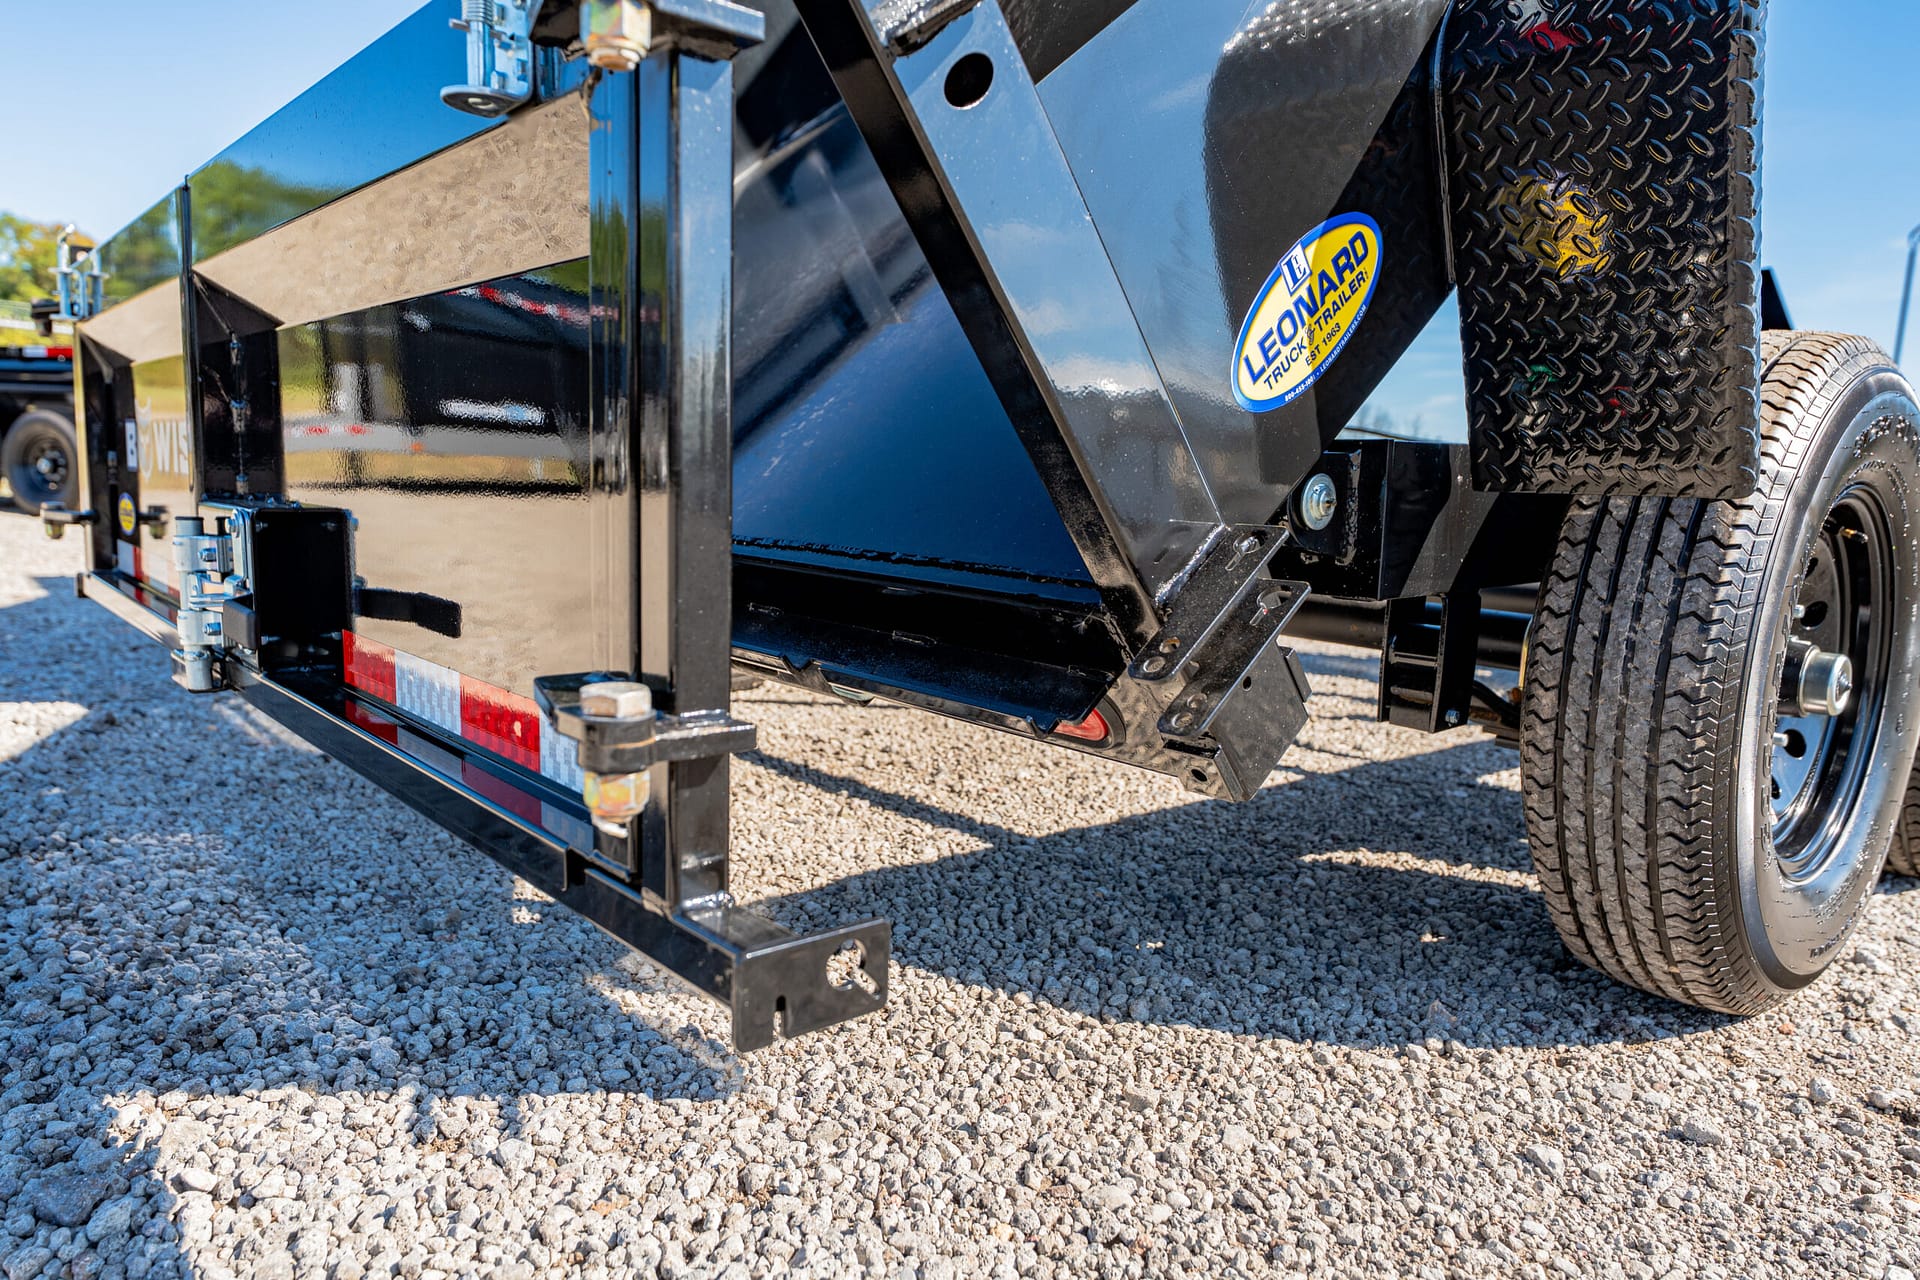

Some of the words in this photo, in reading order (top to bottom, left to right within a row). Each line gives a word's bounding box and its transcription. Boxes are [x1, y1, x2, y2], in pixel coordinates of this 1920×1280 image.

[1243, 231, 1369, 385] LEONARD
[1263, 339, 1309, 390] TRUCK
[1313, 276, 1366, 332] TRAILER
[1305, 346, 1320, 366] EST
[1322, 322, 1341, 347] 1963
